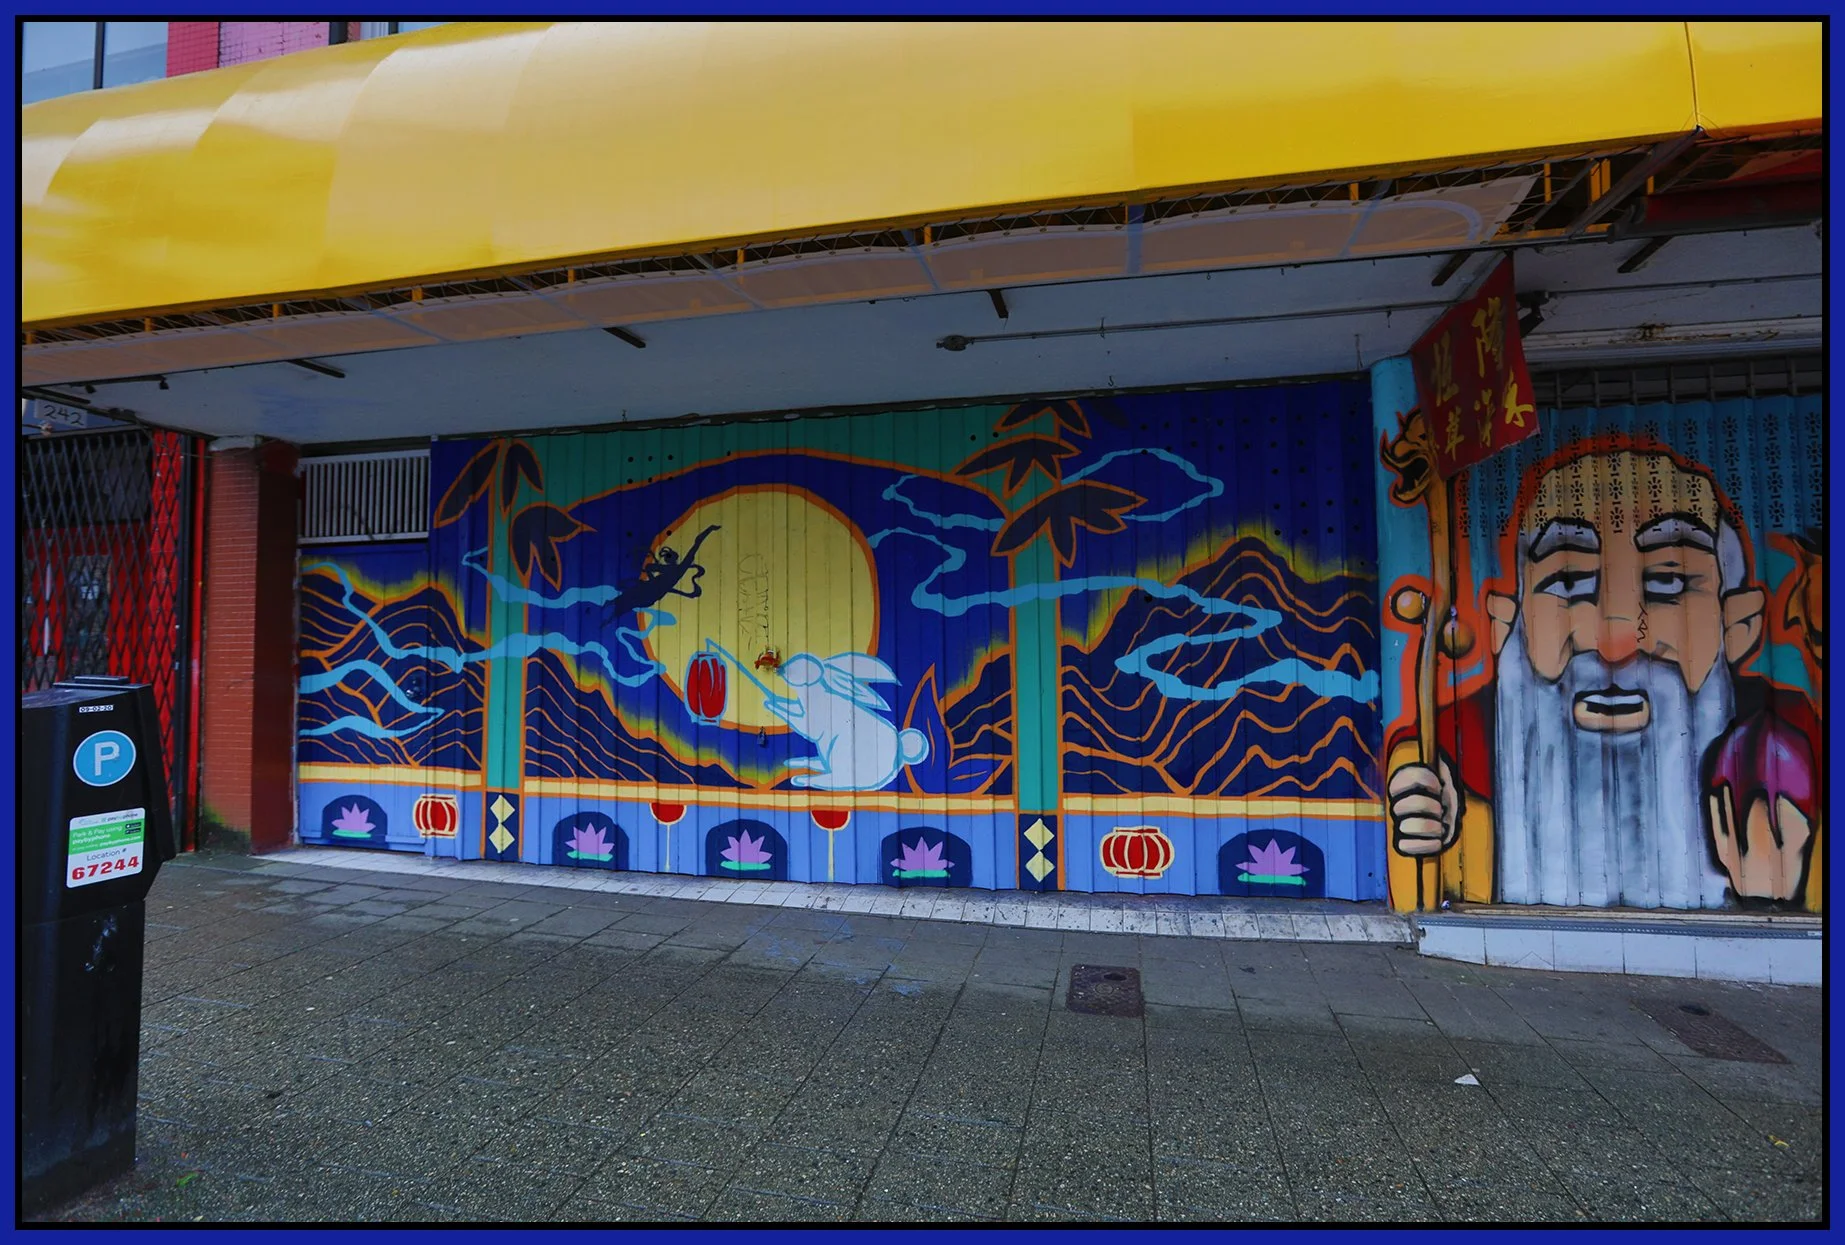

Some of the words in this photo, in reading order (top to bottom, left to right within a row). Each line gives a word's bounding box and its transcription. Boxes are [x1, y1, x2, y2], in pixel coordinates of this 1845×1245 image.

[43, 404, 85, 426] 242
[94, 740, 120, 776] P
[86, 849, 120, 861] Location
[72, 856, 139, 880] 67244
